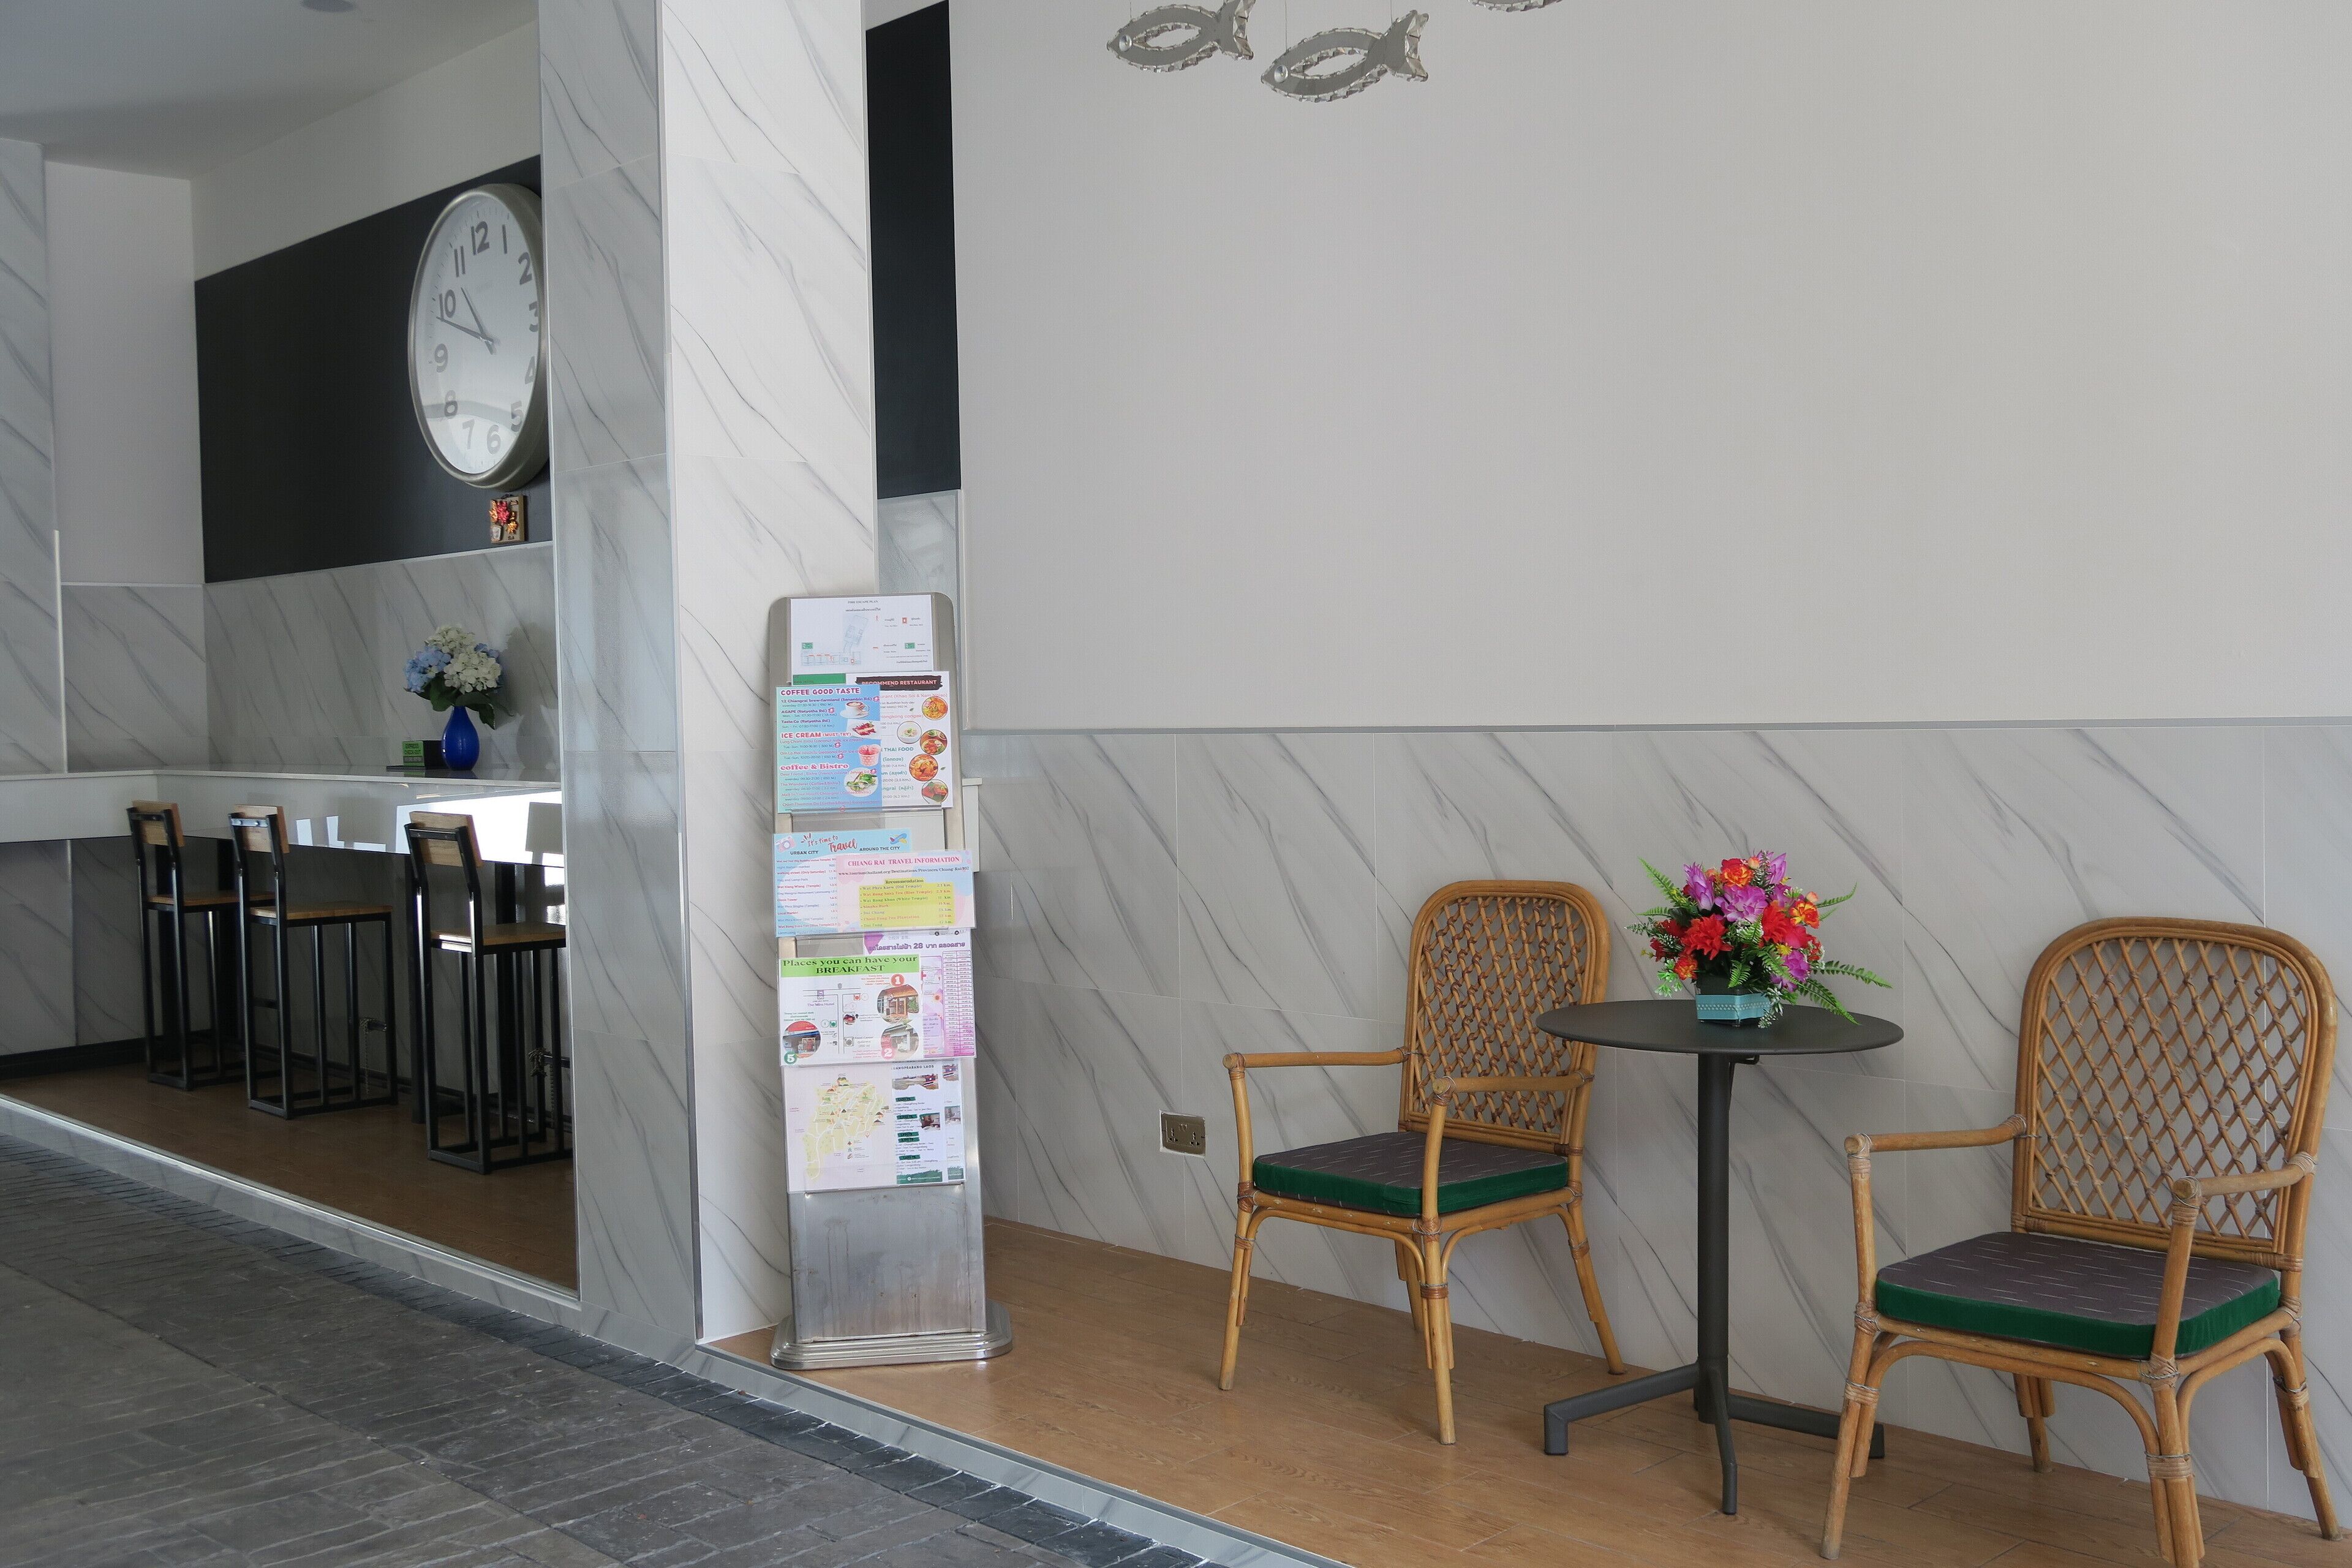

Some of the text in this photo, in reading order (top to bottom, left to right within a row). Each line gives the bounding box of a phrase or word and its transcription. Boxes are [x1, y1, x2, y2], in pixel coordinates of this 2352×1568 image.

[471, 221, 490, 255] 12
[502, 224, 508, 254] 1
[454, 246, 466, 277] 11
[518, 252, 533, 285] 2
[439, 289, 456, 322] 10
[529, 301, 539, 333] 3
[434, 343, 448, 373] 9
[524, 356, 537, 385] 4
[444, 390, 458, 420] 8
[511, 400, 524, 432] 5
[462, 418, 475, 450] 7
[487, 424, 501, 454] 6
[828, 838, 858, 853] Travel
[816, 965, 886, 974] BREAKFAST
[895, 976, 900, 985] 1
[787, 1054, 794, 1063] 5
[884, 1048, 892, 1057] 2
